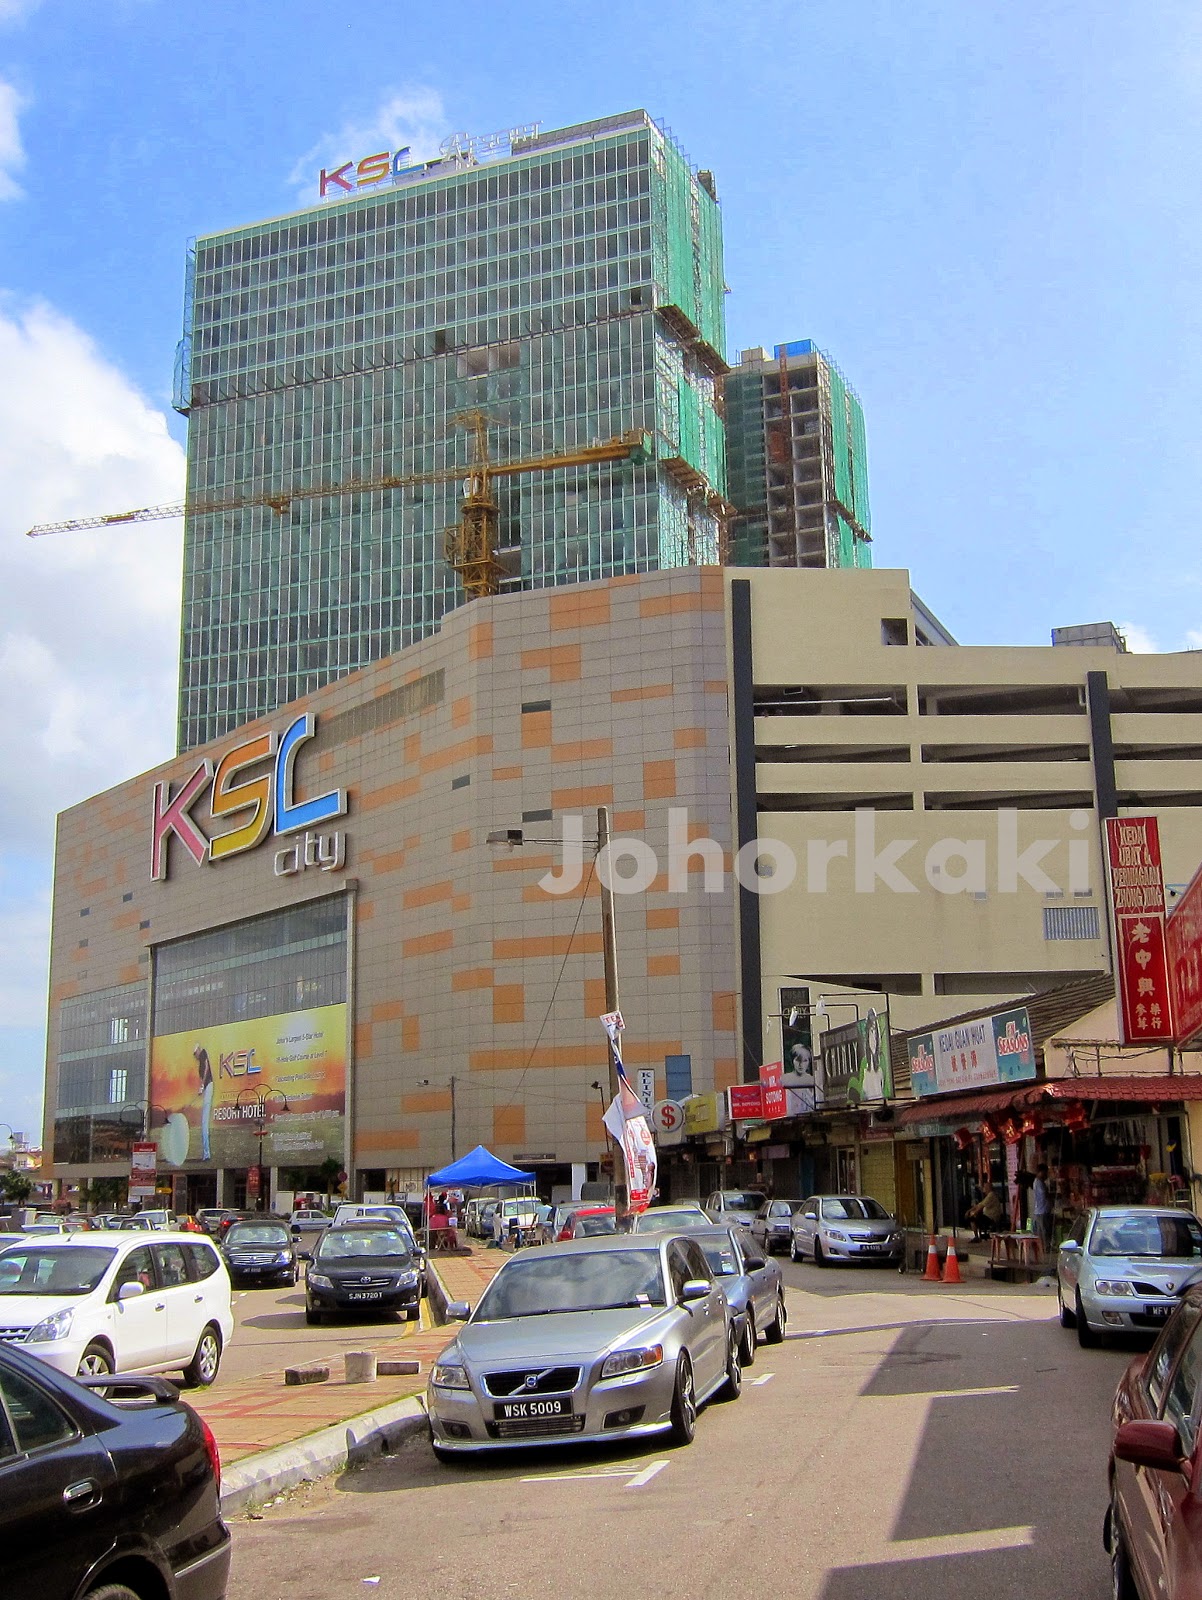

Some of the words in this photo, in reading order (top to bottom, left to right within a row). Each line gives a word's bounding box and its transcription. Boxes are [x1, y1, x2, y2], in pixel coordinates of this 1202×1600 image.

[320, 146, 425, 197] KSL
[150, 711, 348, 882] KSL
[274, 831, 346, 876] city
[998, 1033, 1029, 1056] SEASONS
[219, 1049, 262, 1079] KSL
[504, 1404, 527, 1417] WSK
[530, 1401, 561, 1414] 5009
